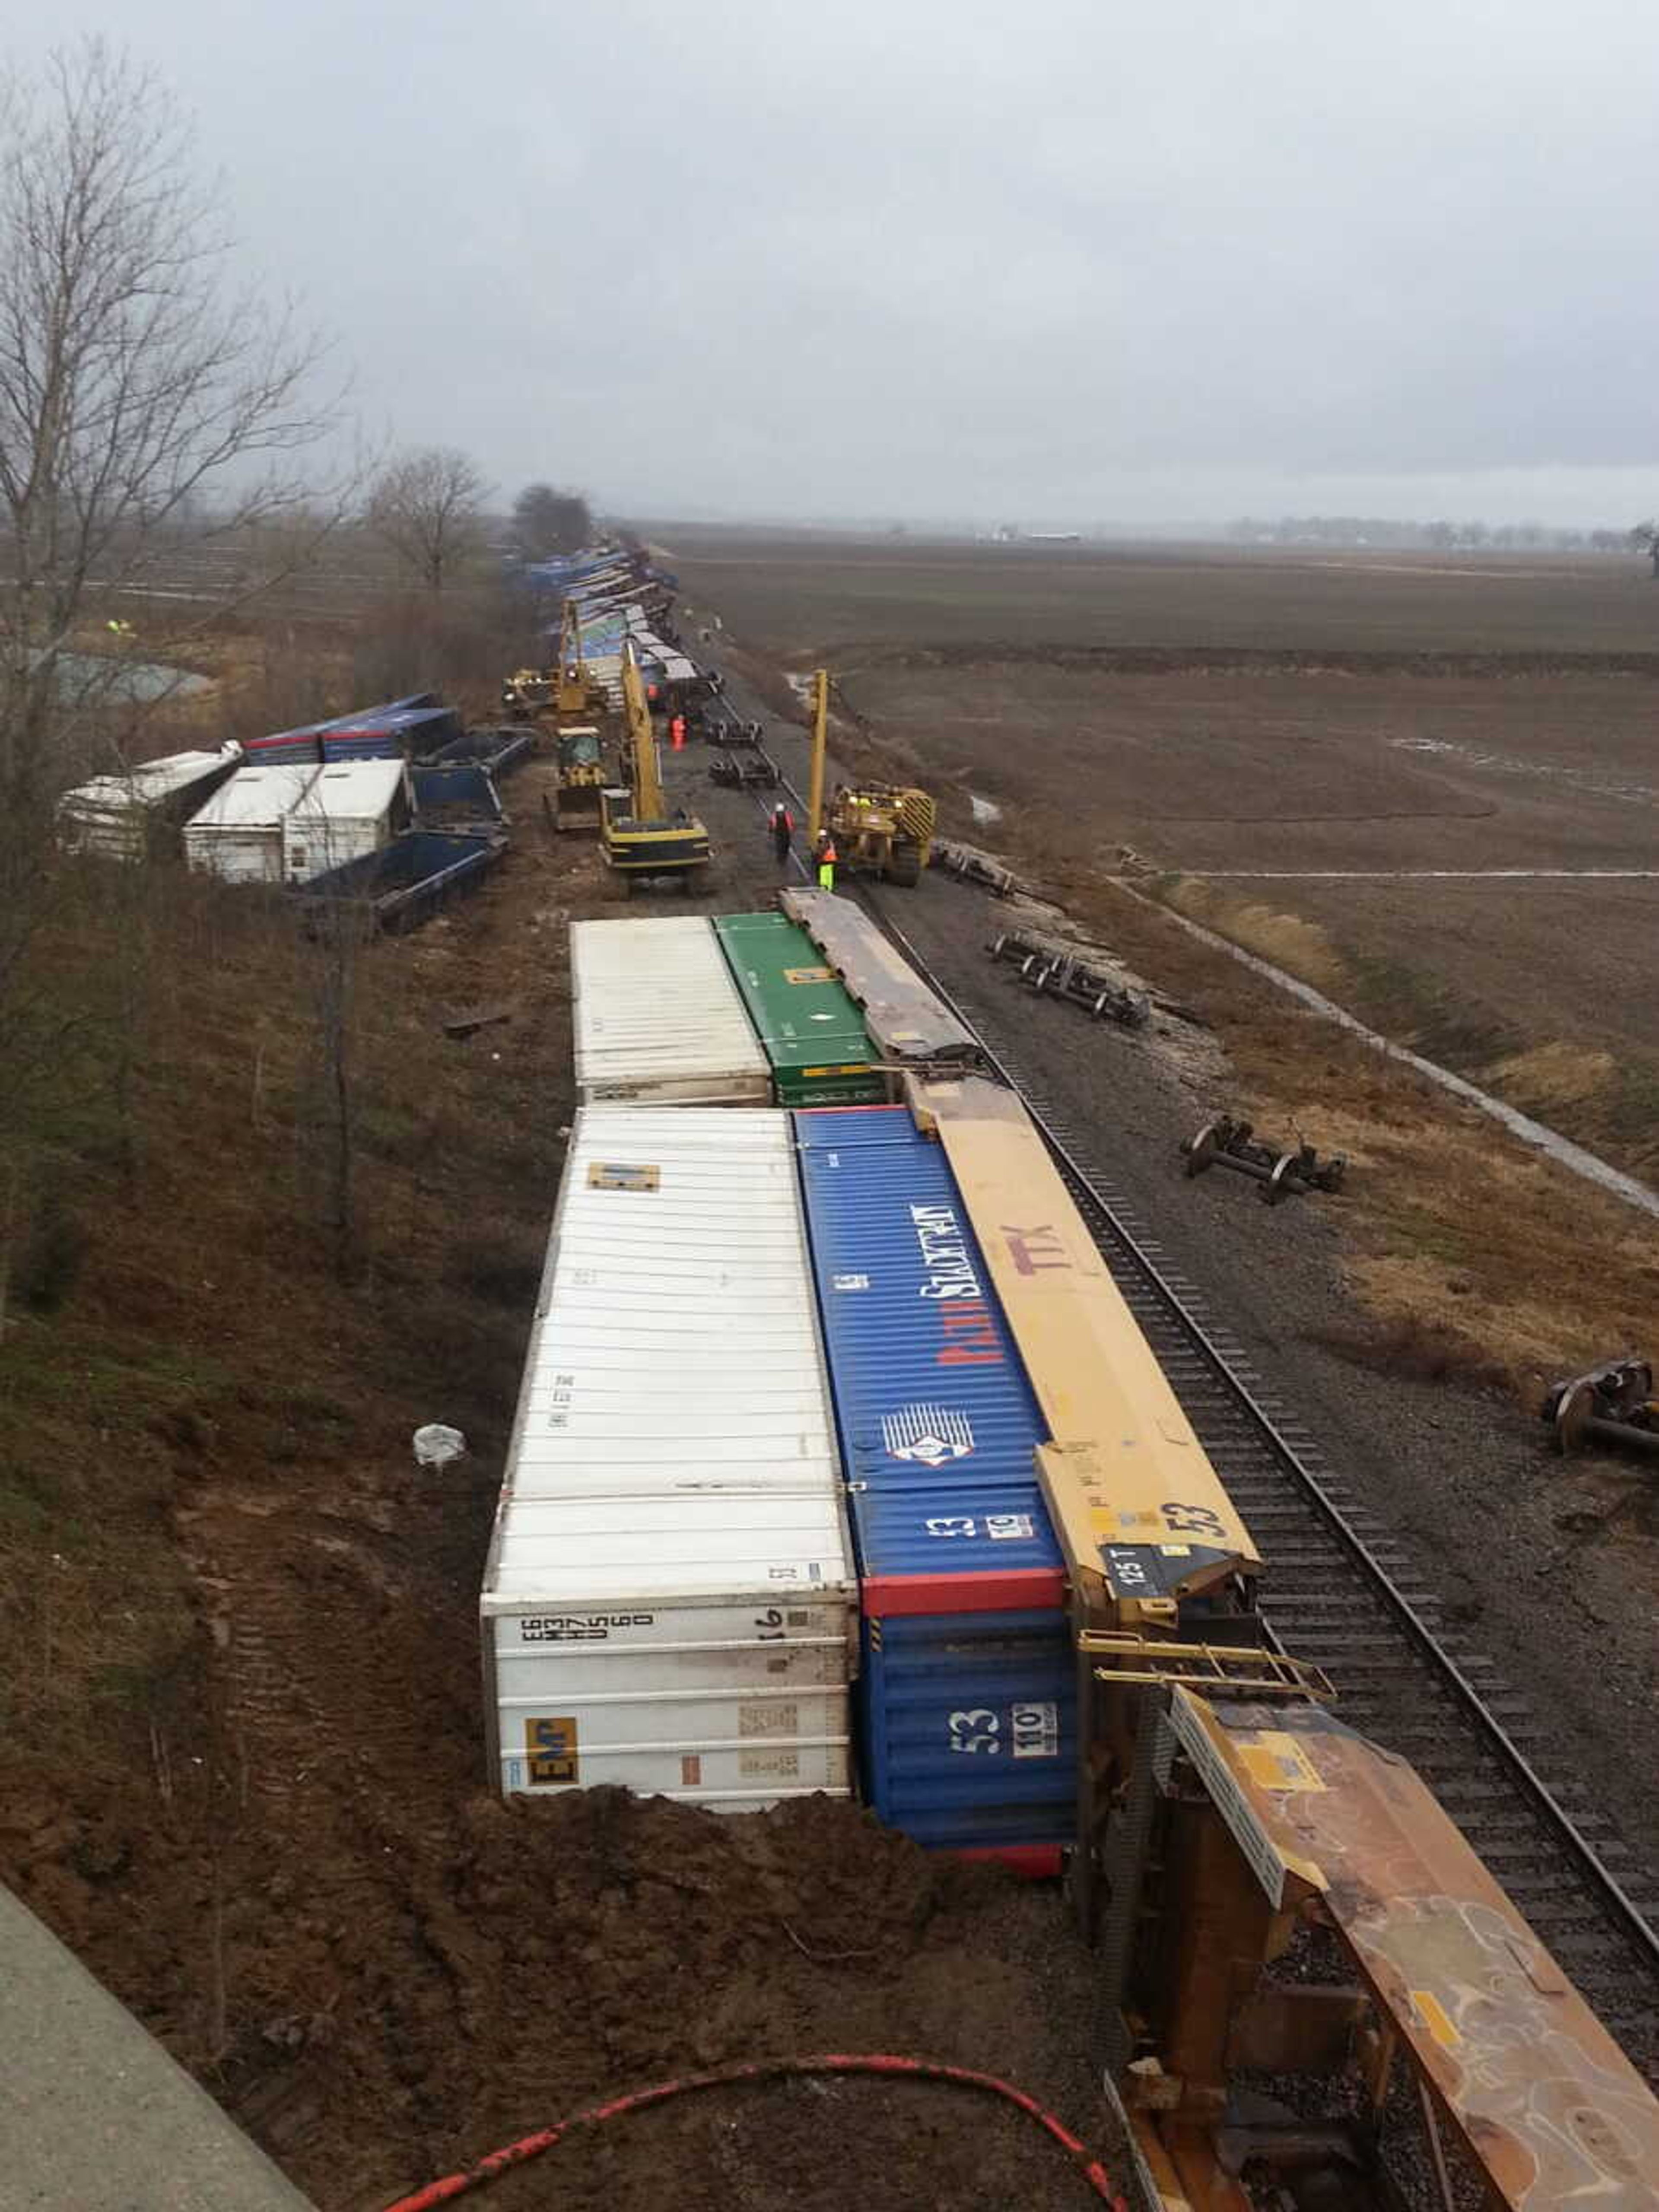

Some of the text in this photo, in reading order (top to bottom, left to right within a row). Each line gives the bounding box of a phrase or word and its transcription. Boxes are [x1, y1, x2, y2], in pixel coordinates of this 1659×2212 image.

[1000, 1224, 1073, 1276] TTX
[1161, 1503, 1226, 1538] 53
[1115, 1561, 1147, 1585] 125
[521, 1615, 653, 1629] 637560
[522, 1629, 608, 1641] EMHU
[949, 1709, 1001, 1754] 53
